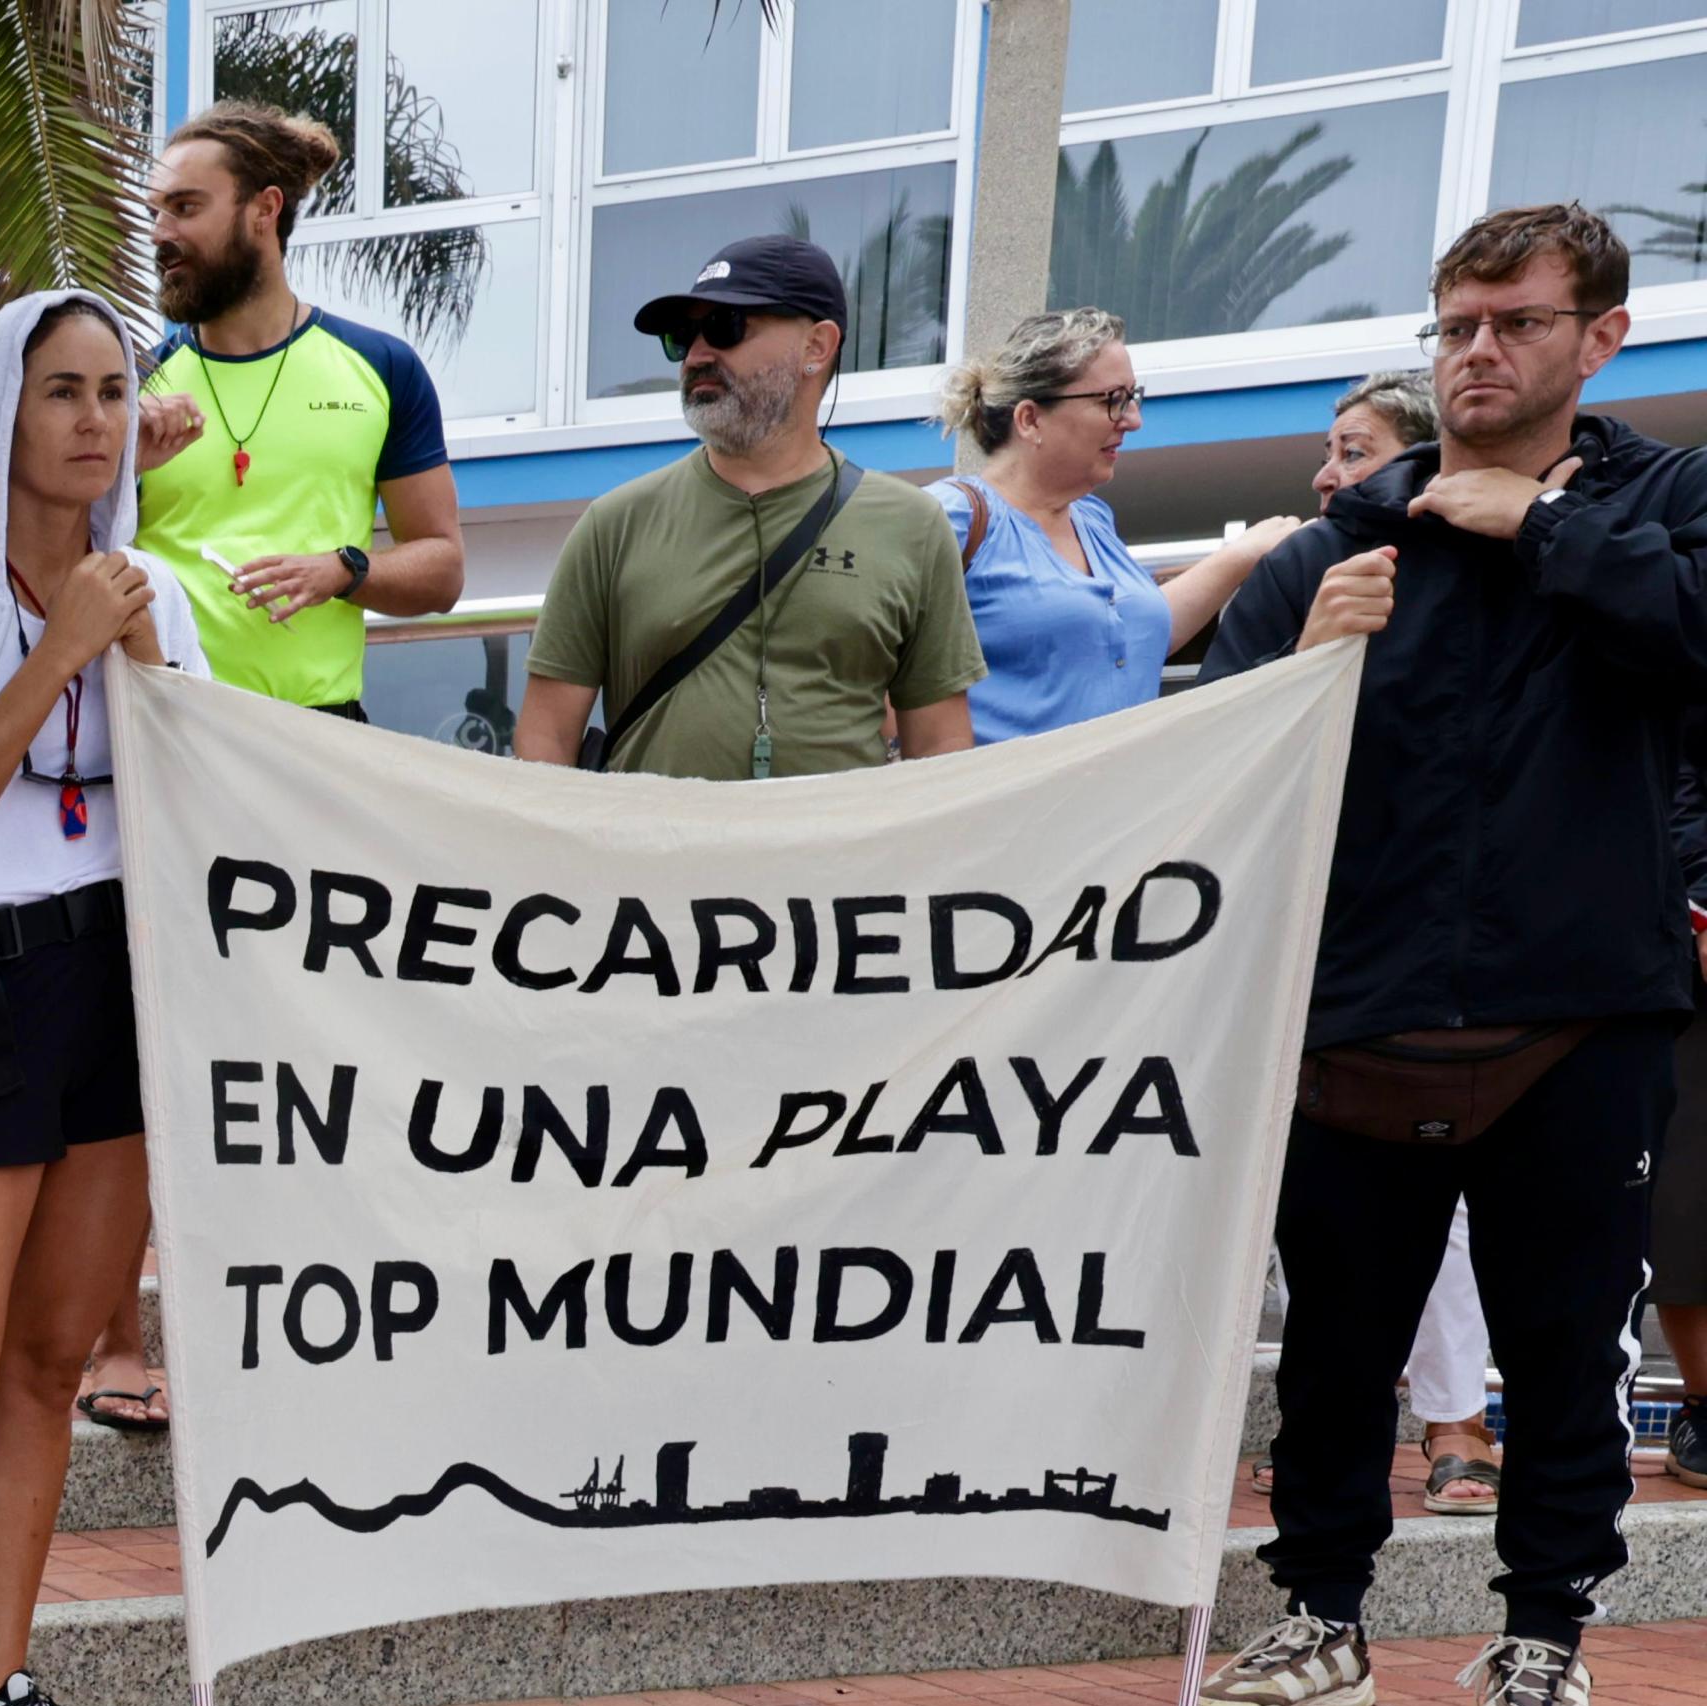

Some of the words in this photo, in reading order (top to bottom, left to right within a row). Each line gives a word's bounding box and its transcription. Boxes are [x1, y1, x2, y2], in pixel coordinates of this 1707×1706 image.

[206, 855, 1223, 998] PRECARIEDAD
[209, 1059, 357, 1166] EN
[407, 1079, 708, 1189] UNA
[749, 1054, 1202, 1170] PLAYA
[224, 1261, 440, 1370] TOP
[487, 1245, 1147, 1356] MUNDIAL
